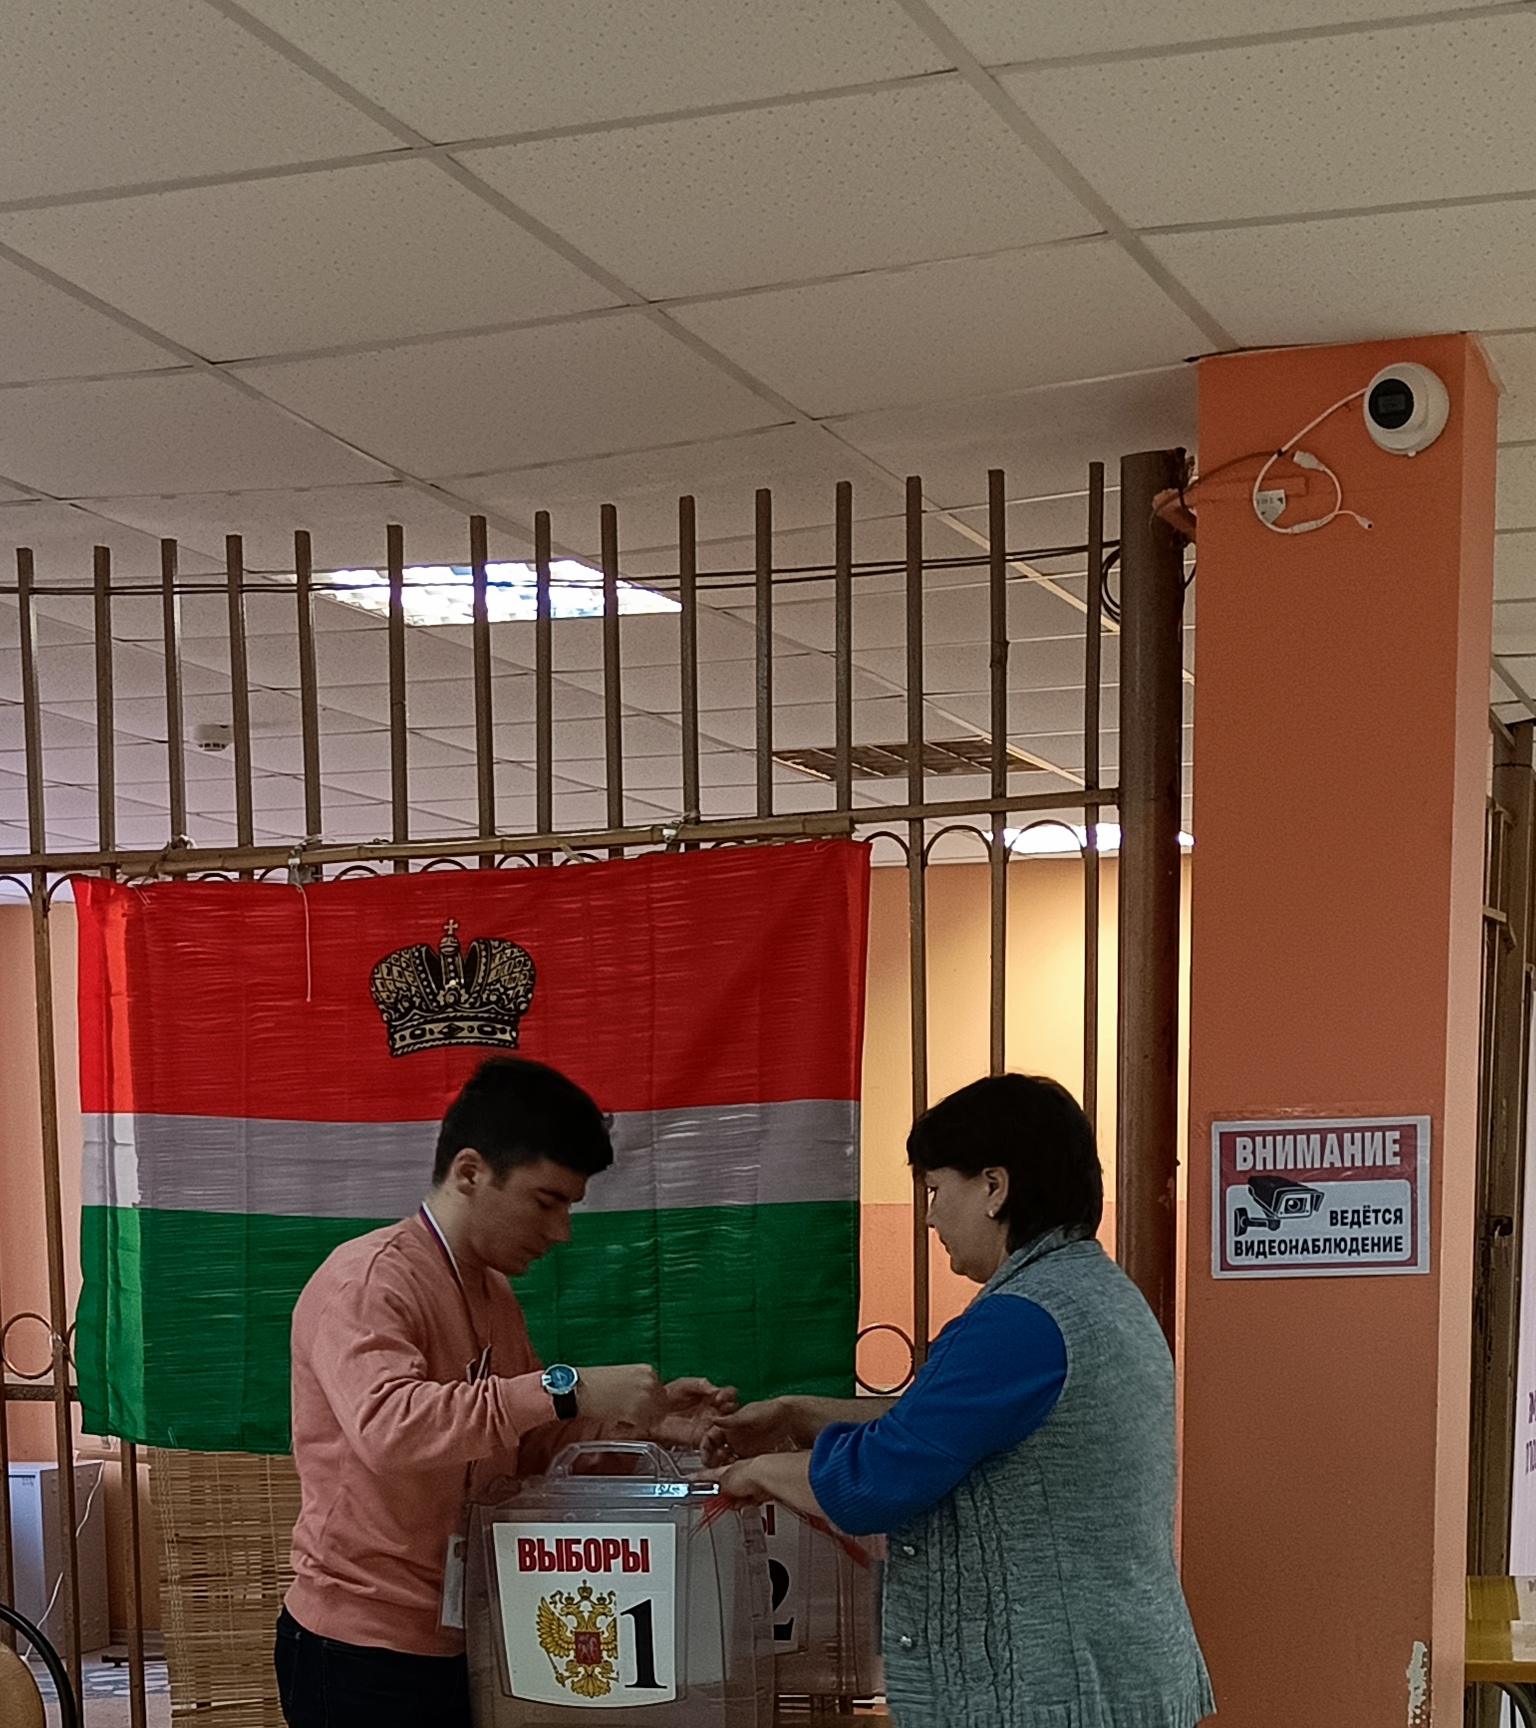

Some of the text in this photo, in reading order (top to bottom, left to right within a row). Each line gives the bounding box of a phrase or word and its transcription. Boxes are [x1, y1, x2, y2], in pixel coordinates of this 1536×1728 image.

[1235, 1131, 1401, 1171] ВНИМАНИЕ
[1329, 1205, 1403, 1229] ВЕДЁТСЯ
[1234, 1236, 1403, 1259] ВИДЕОНАБЛЮДЕНИЕ
[518, 1538, 650, 1573] ВЫБОРЫ
[620, 1599, 668, 1690] 1
